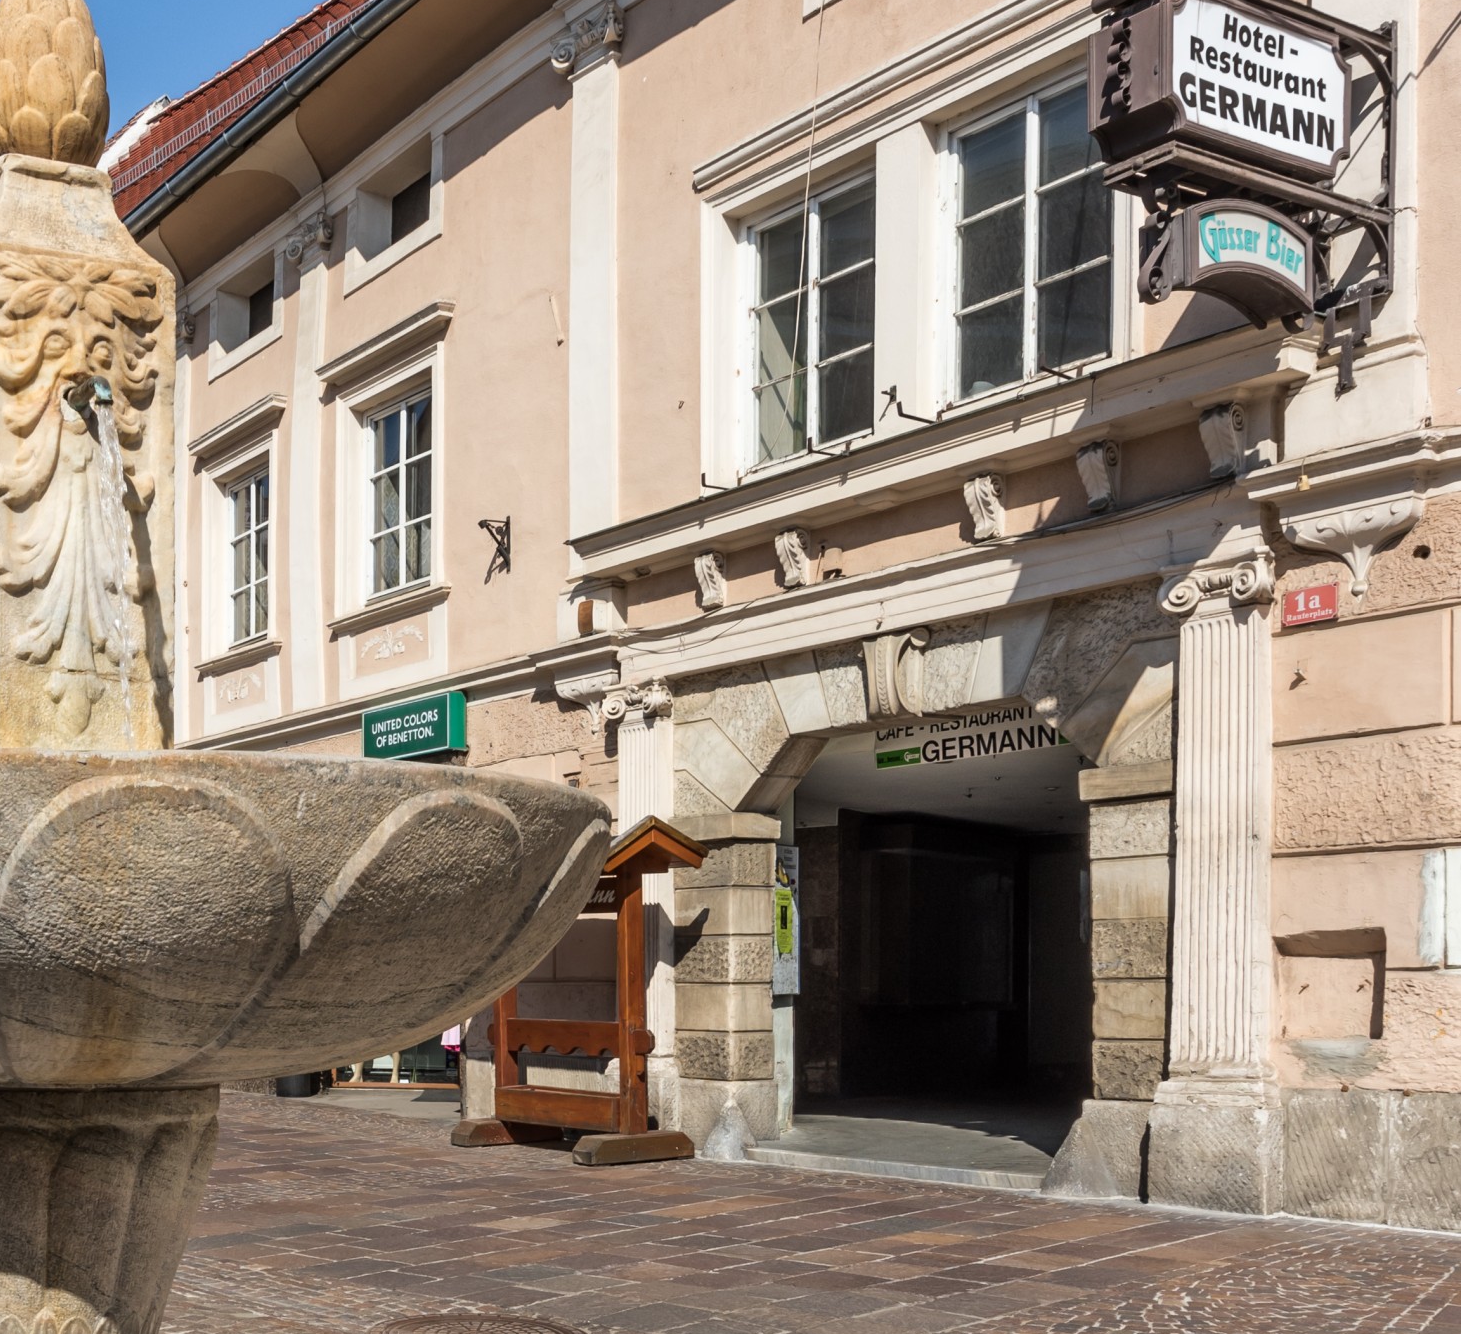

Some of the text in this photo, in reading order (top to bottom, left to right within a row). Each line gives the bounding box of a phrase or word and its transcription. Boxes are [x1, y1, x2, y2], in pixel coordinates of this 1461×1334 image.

[1223, 13, 1285, 60] Hotel
[1190, 35, 1327, 102] Restaurant
[1179, 72, 1335, 152] GERMANN
[1200, 212, 1303, 275] Gösser Bier
[1295, 592, 1321, 612] 1a
[371, 709, 438, 734] UNITED COLORS
[376, 726, 434, 748] OF BENETTON.
[921, 725, 1057, 763] GERMANN
